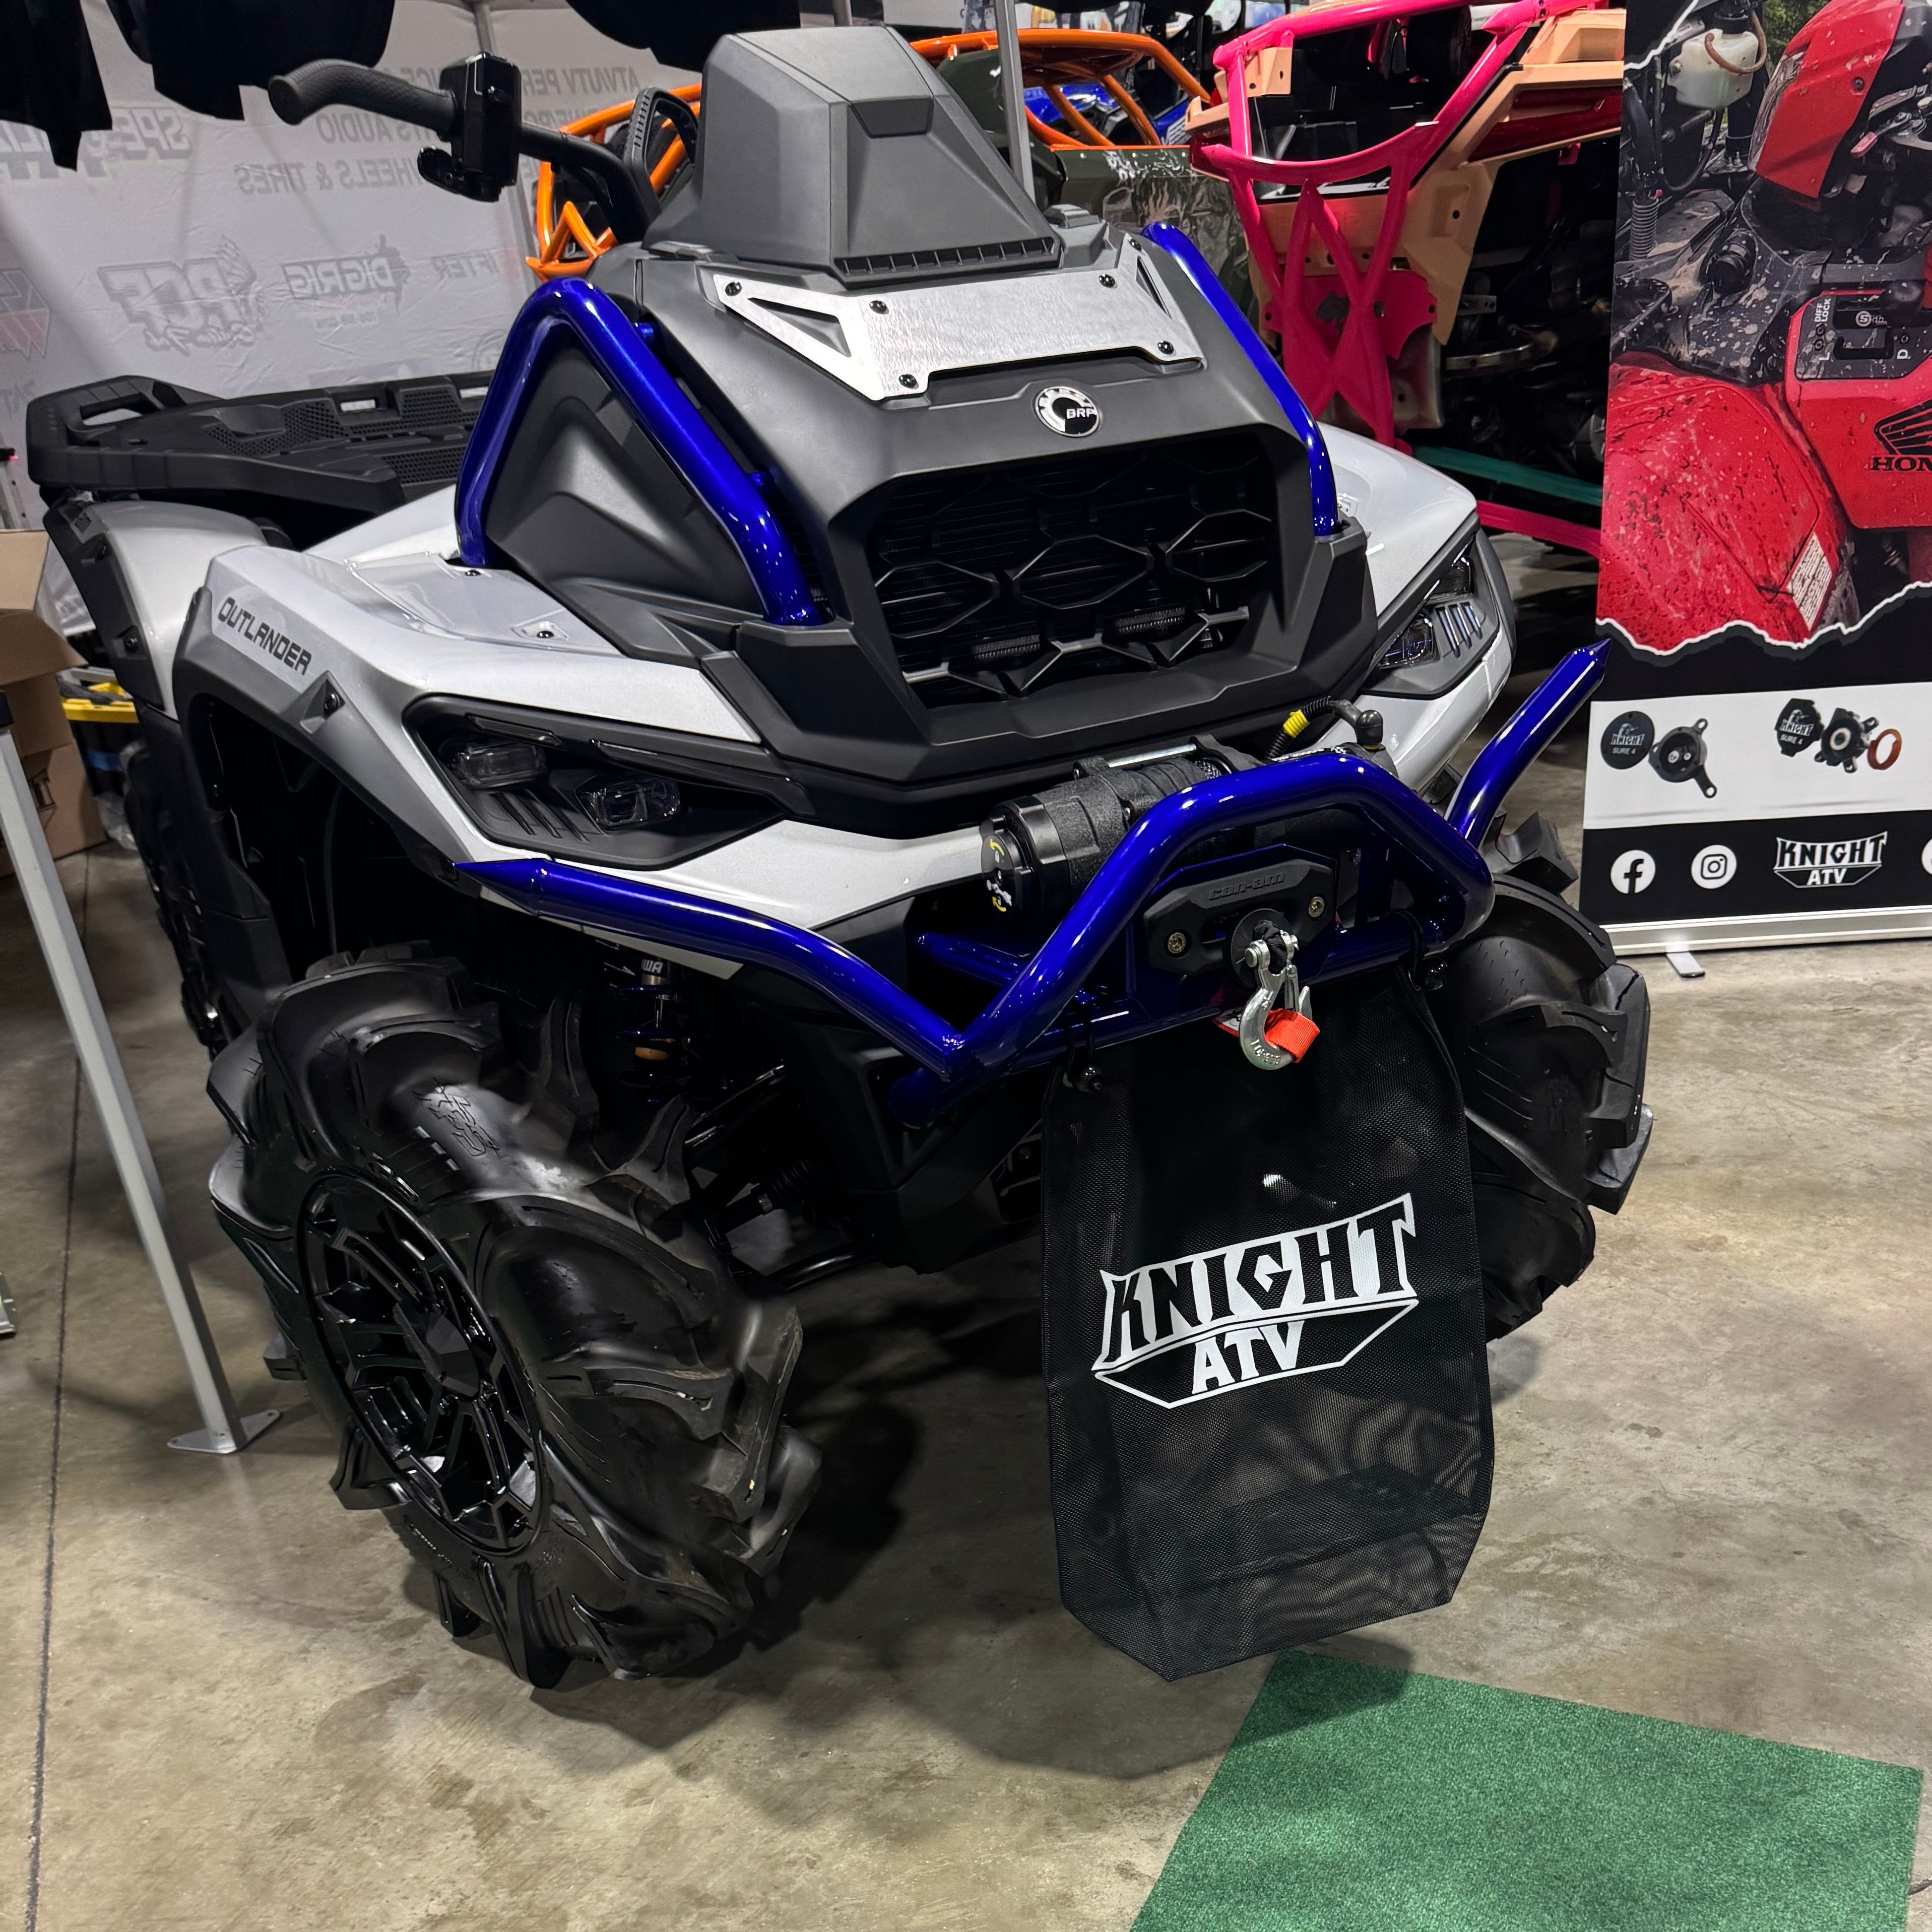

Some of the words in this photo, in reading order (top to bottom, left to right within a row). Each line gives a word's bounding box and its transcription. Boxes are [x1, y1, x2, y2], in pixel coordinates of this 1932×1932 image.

[1814, 303, 1823, 323] DIFF
[1821, 298, 1831, 323] LOCK
[1066, 408, 1097, 419] BRP
[218, 597, 312, 676] OUTLANDER
[1773, 831, 1888, 870] KNIGHT
[1208, 873, 1285, 900] can-am
[1806, 868, 1847, 886] ATV
[1092, 1193, 1417, 1371] KNIGHT
[1192, 1320, 1305, 1395] ATV
